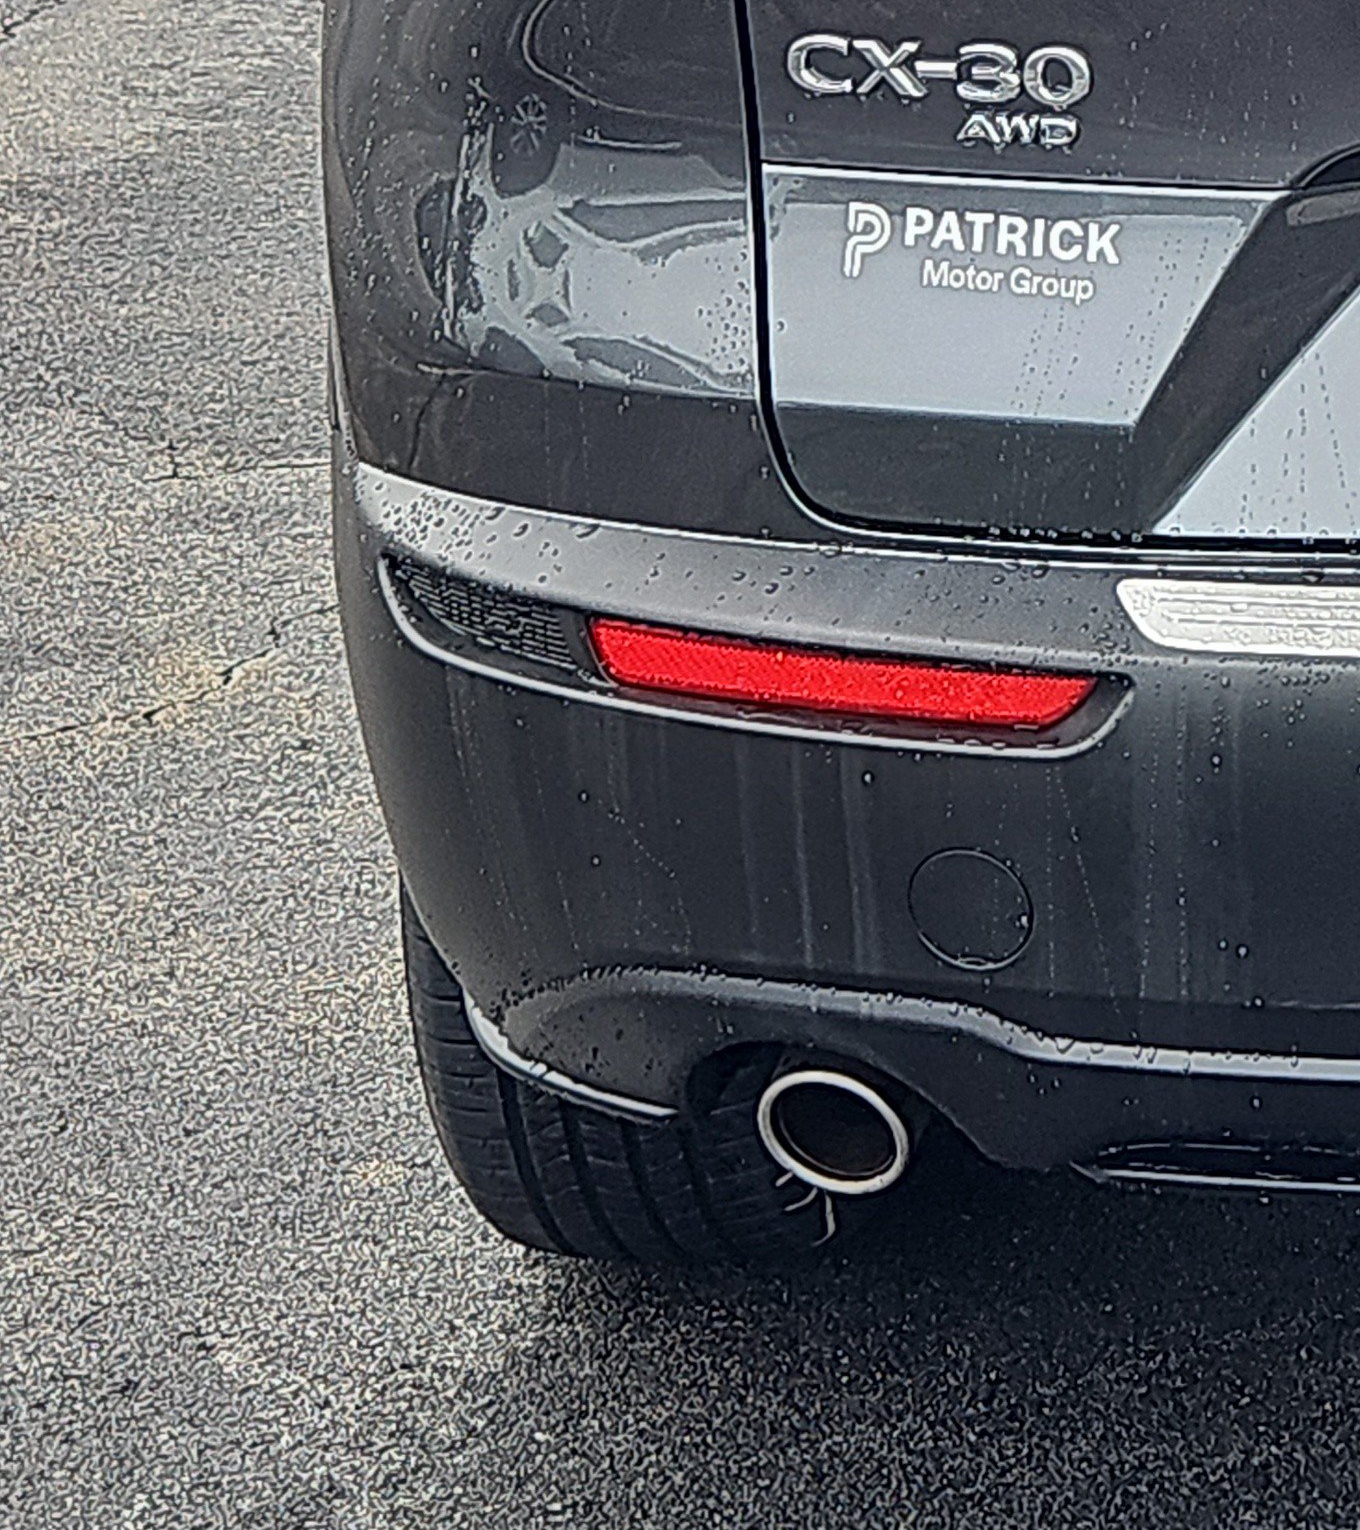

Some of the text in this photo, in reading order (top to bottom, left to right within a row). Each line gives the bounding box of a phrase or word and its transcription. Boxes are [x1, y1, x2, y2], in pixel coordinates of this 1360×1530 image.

[786, 33, 1092, 107] CX-30
[957, 112, 1080, 147] AWD
[904, 206, 1121, 265] PATRICK
[922, 259, 1094, 306] Motor Group
